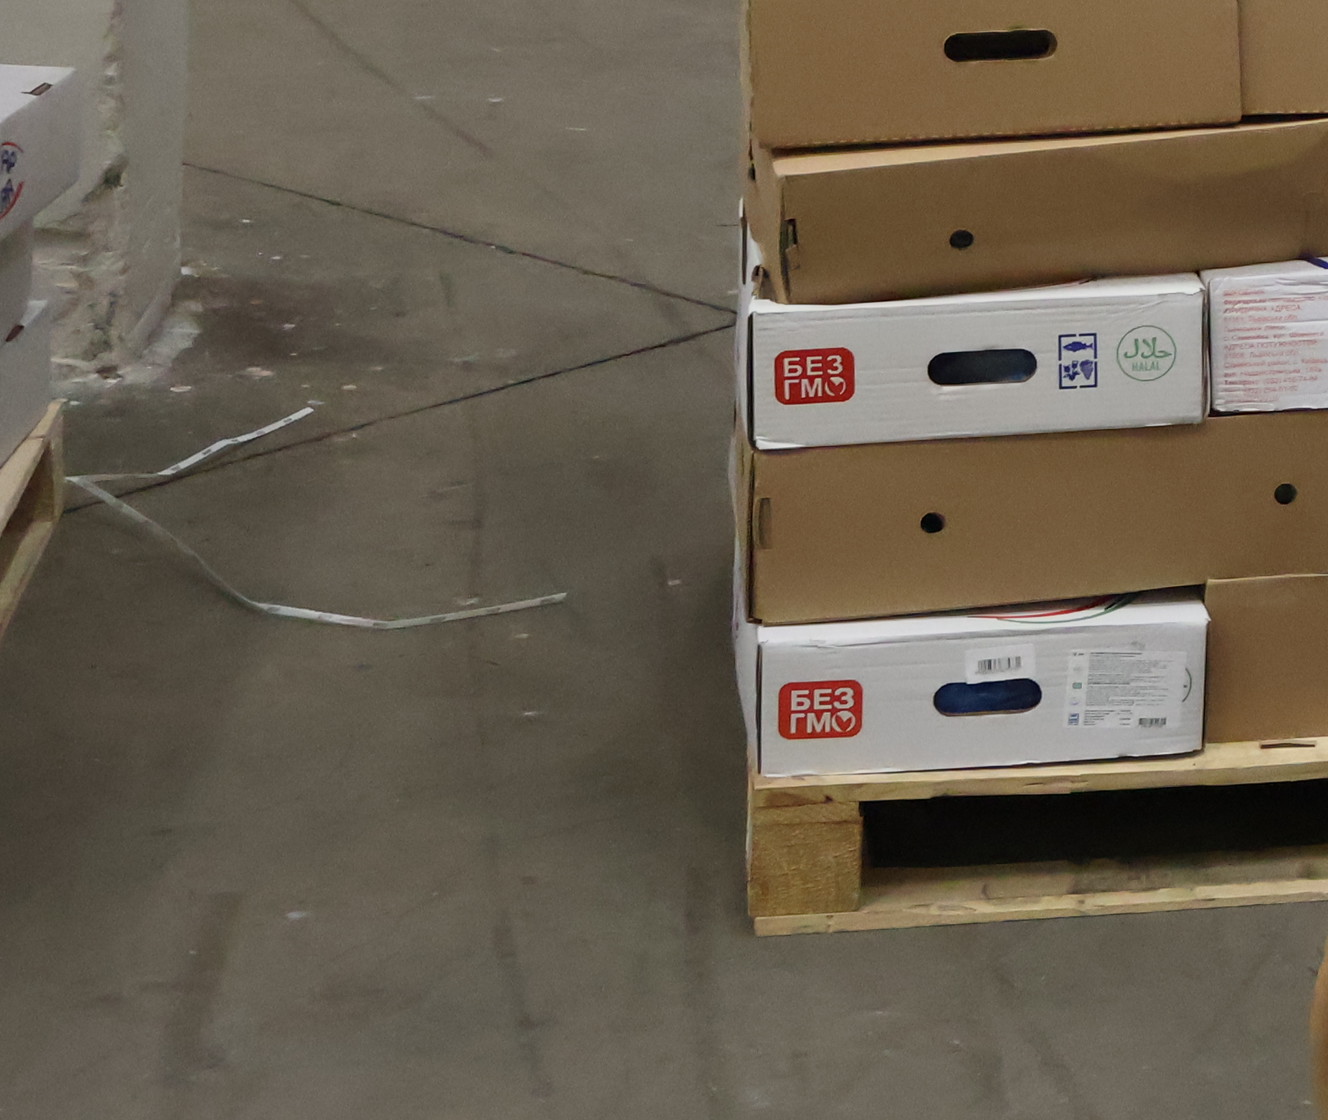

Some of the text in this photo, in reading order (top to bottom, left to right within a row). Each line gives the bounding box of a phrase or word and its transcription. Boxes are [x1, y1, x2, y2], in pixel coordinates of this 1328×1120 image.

[1124, 337, 1173, 359] حلال
[783, 354, 844, 377] БЕЗ
[1131, 361, 1161, 372] HALAL
[784, 376, 847, 400] ГМО
[790, 687, 855, 711] БЕЗ
[789, 710, 856, 734] ГМО
